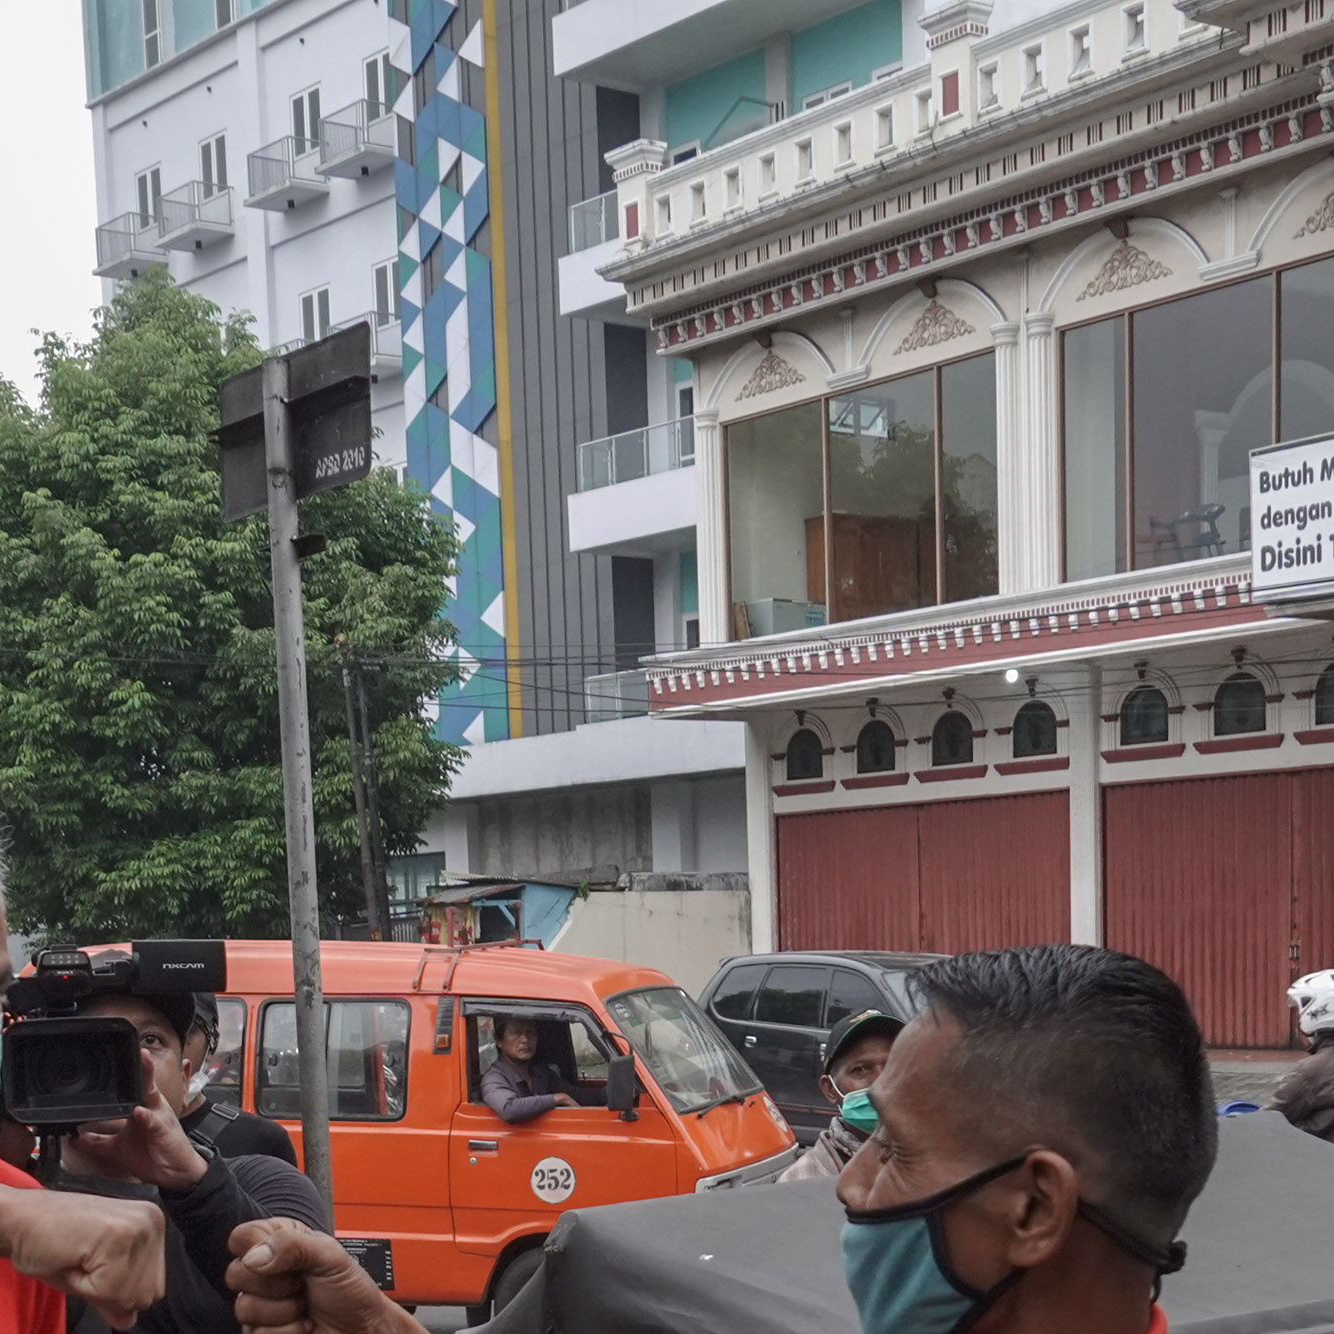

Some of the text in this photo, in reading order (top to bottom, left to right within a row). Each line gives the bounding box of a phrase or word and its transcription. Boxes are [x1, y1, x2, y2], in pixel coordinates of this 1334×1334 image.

[1260, 461, 1314, 494] Butuh
[1260, 499, 1333, 531] dengan
[1260, 536, 1323, 573] Disini
[534, 1168, 572, 1191] 252
